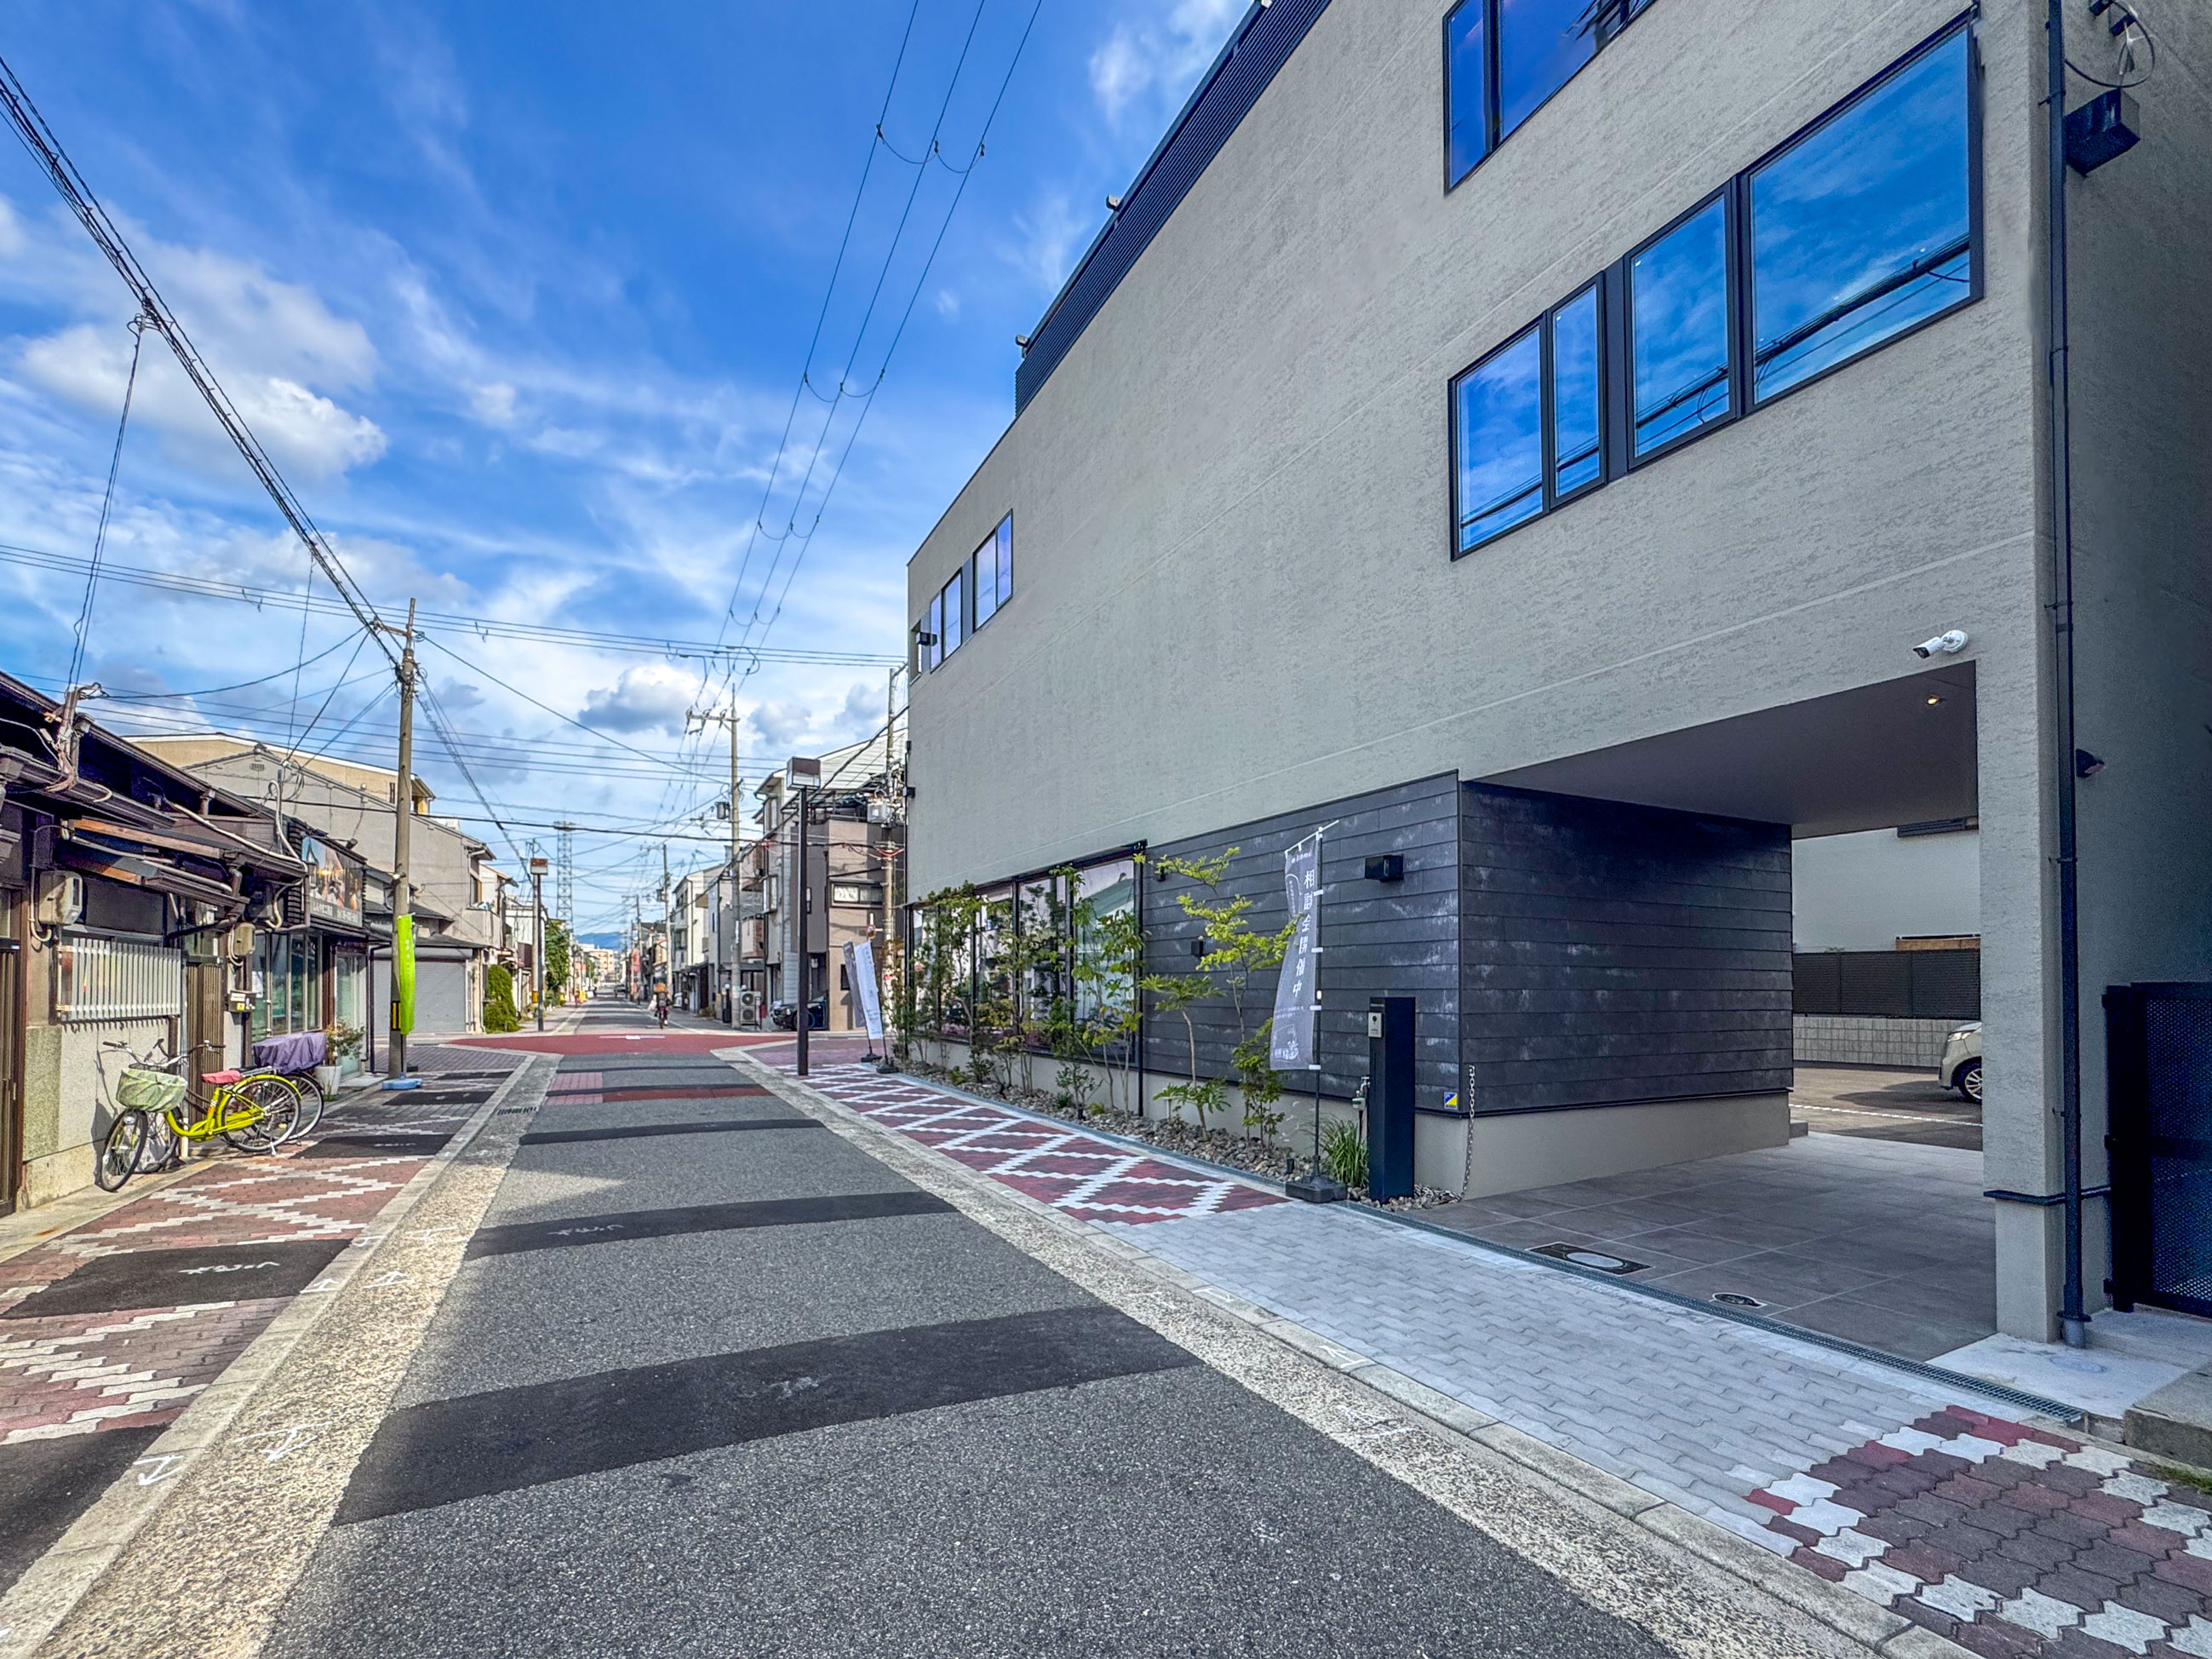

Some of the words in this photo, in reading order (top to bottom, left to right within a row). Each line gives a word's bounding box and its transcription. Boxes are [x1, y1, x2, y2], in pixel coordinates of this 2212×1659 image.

[1292, 869, 1315, 997] 相談会開催中
